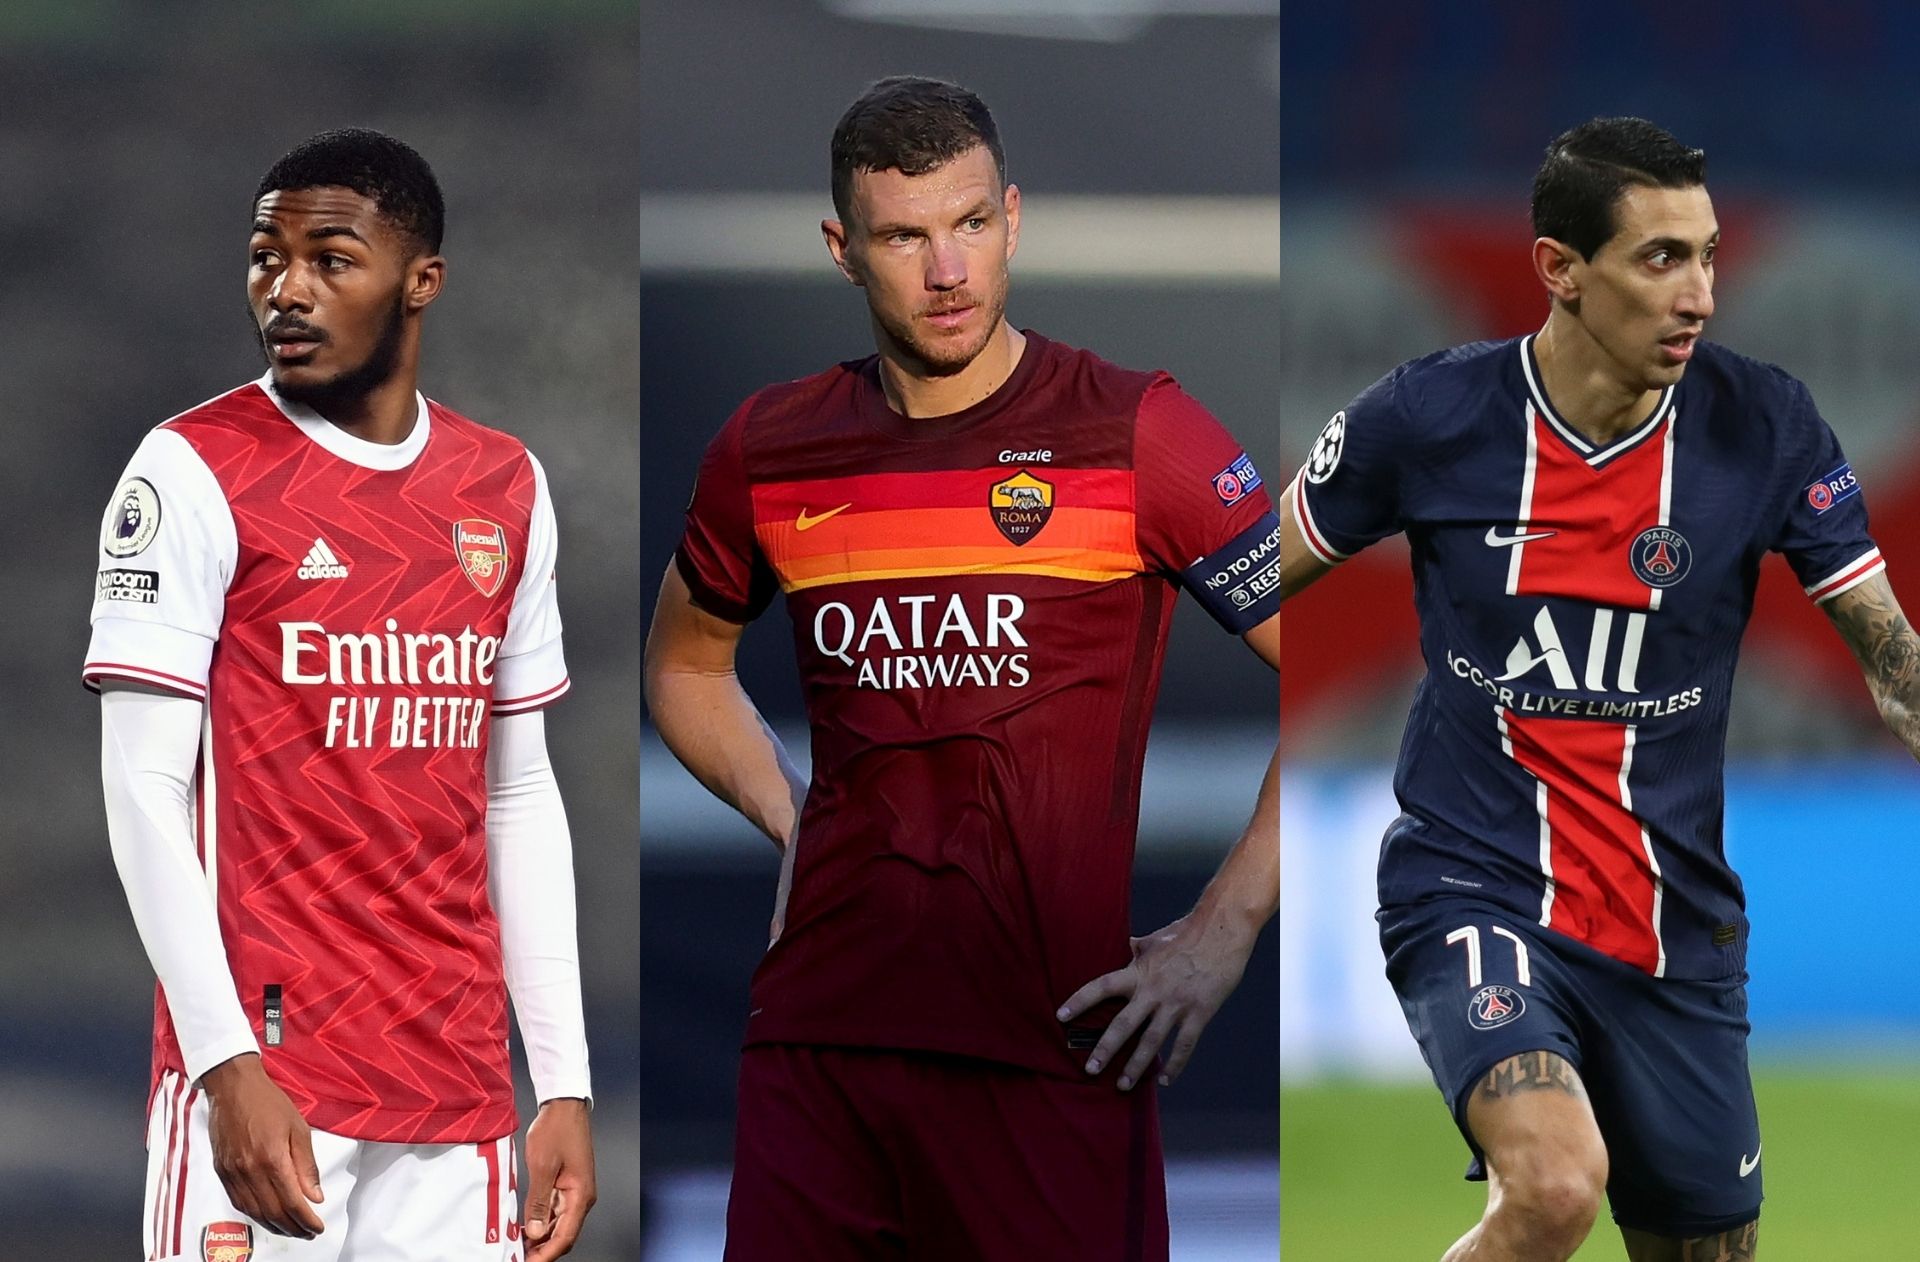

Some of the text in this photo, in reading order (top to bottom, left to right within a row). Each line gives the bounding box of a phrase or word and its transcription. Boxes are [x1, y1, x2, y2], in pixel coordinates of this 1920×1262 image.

[999, 512, 1042, 524] ROMA
[460, 531, 499, 546] Arsenal
[1011, 526, 1030, 534] 1927
[1643, 531, 1683, 548] PARIS
[297, 562, 349, 580] adidas
[1205, 571, 1230, 591] NO
[1227, 557, 1251, 576] TO
[109, 572, 152, 589] room
[814, 593, 1029, 667] QATAR
[278, 618, 501, 686] Emirate
[857, 653, 1030, 690] AIRWAYS
[1448, 649, 1702, 718] ACCOR LIVE LIMITLESS
[324, 697, 486, 748] FLY BETTER
[1473, 987, 1510, 1004] PARIS
[207, 1231, 247, 1242] Arsenal
